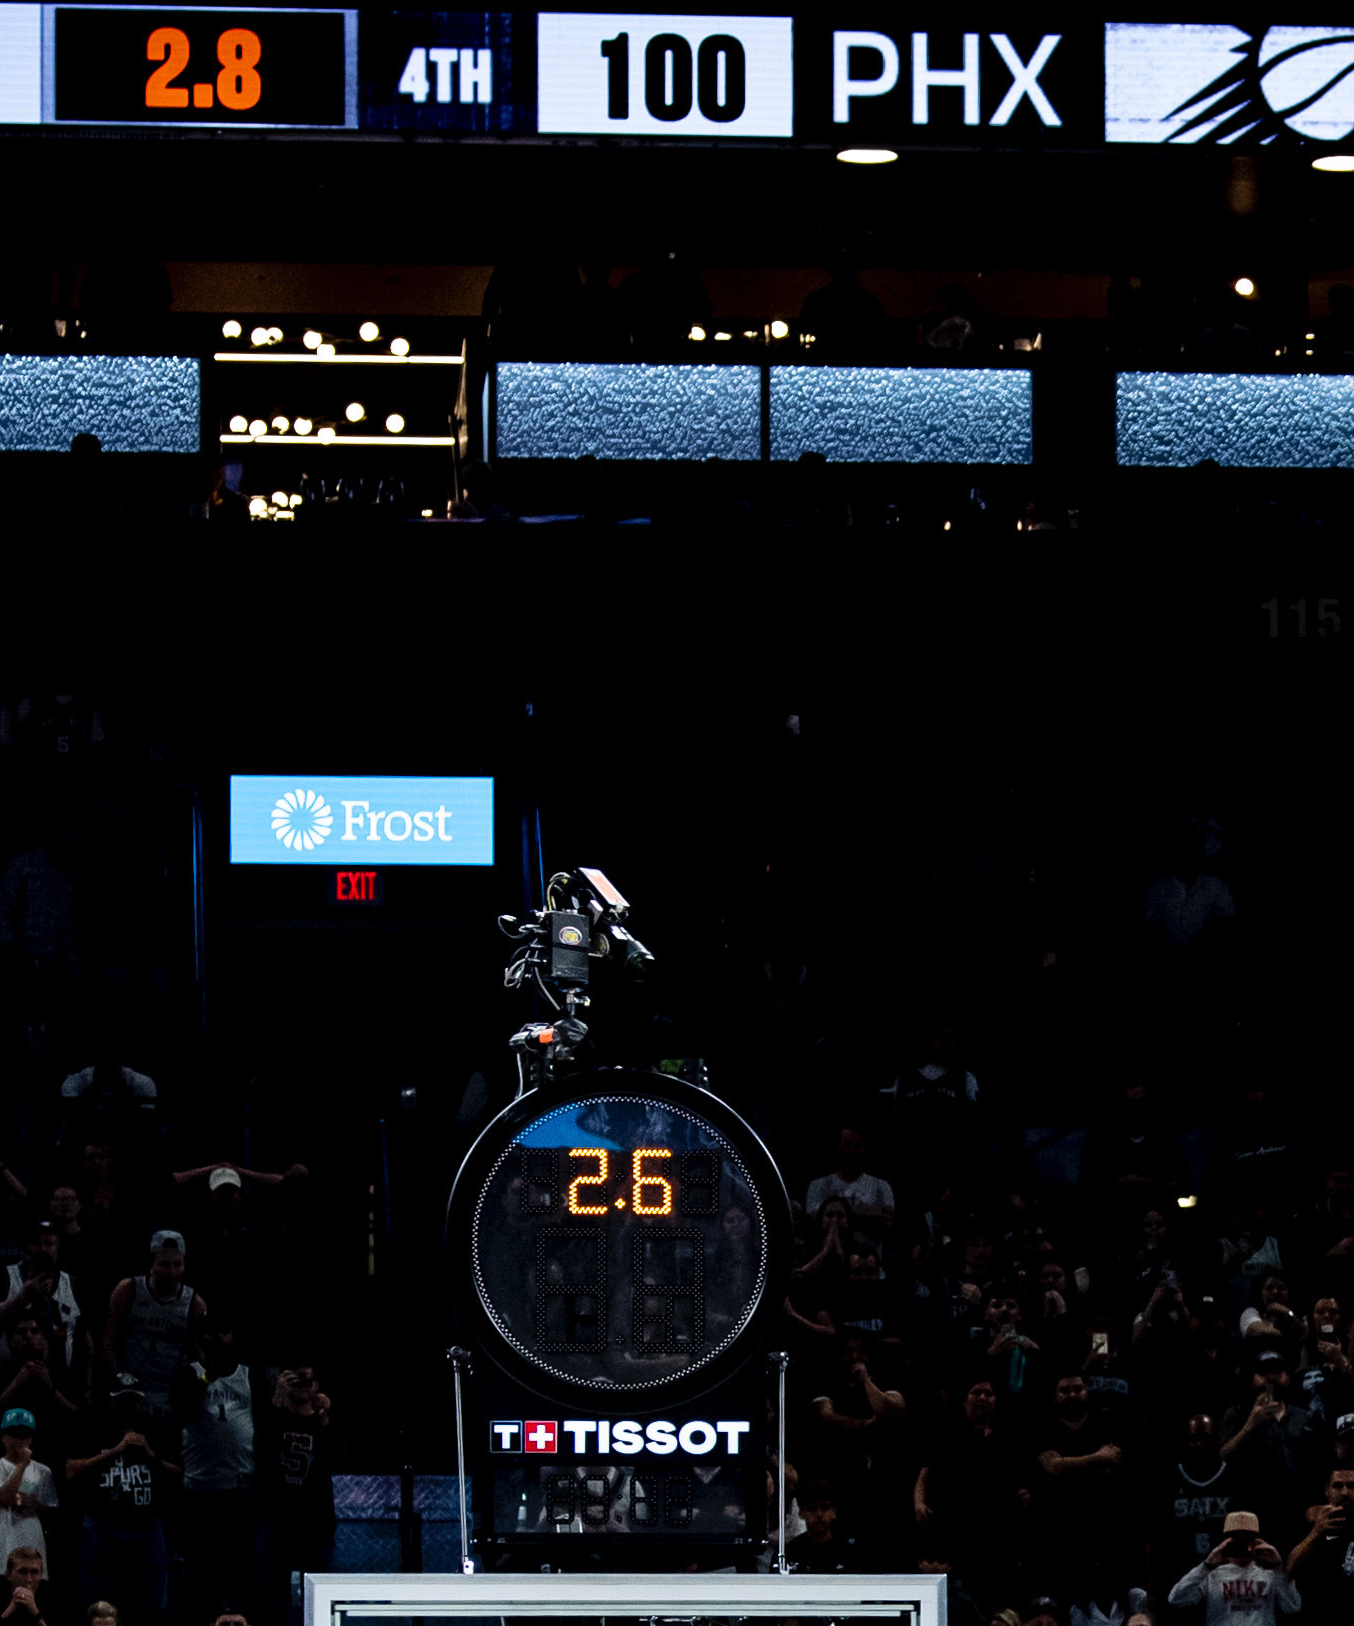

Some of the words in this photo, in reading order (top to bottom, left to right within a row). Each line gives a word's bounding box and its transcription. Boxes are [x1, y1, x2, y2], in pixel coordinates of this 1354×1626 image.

[145, 27, 261, 110] 2.8
[398, 47, 492, 104] 4TH
[602, 33, 745, 122] 100
[833, 31, 1062, 126] PHX
[341, 801, 452, 841] Frost
[337, 872, 376, 899] EXIT
[569, 1148, 673, 1216] 2.6
[564, 1421, 749, 1454] TISSOT
